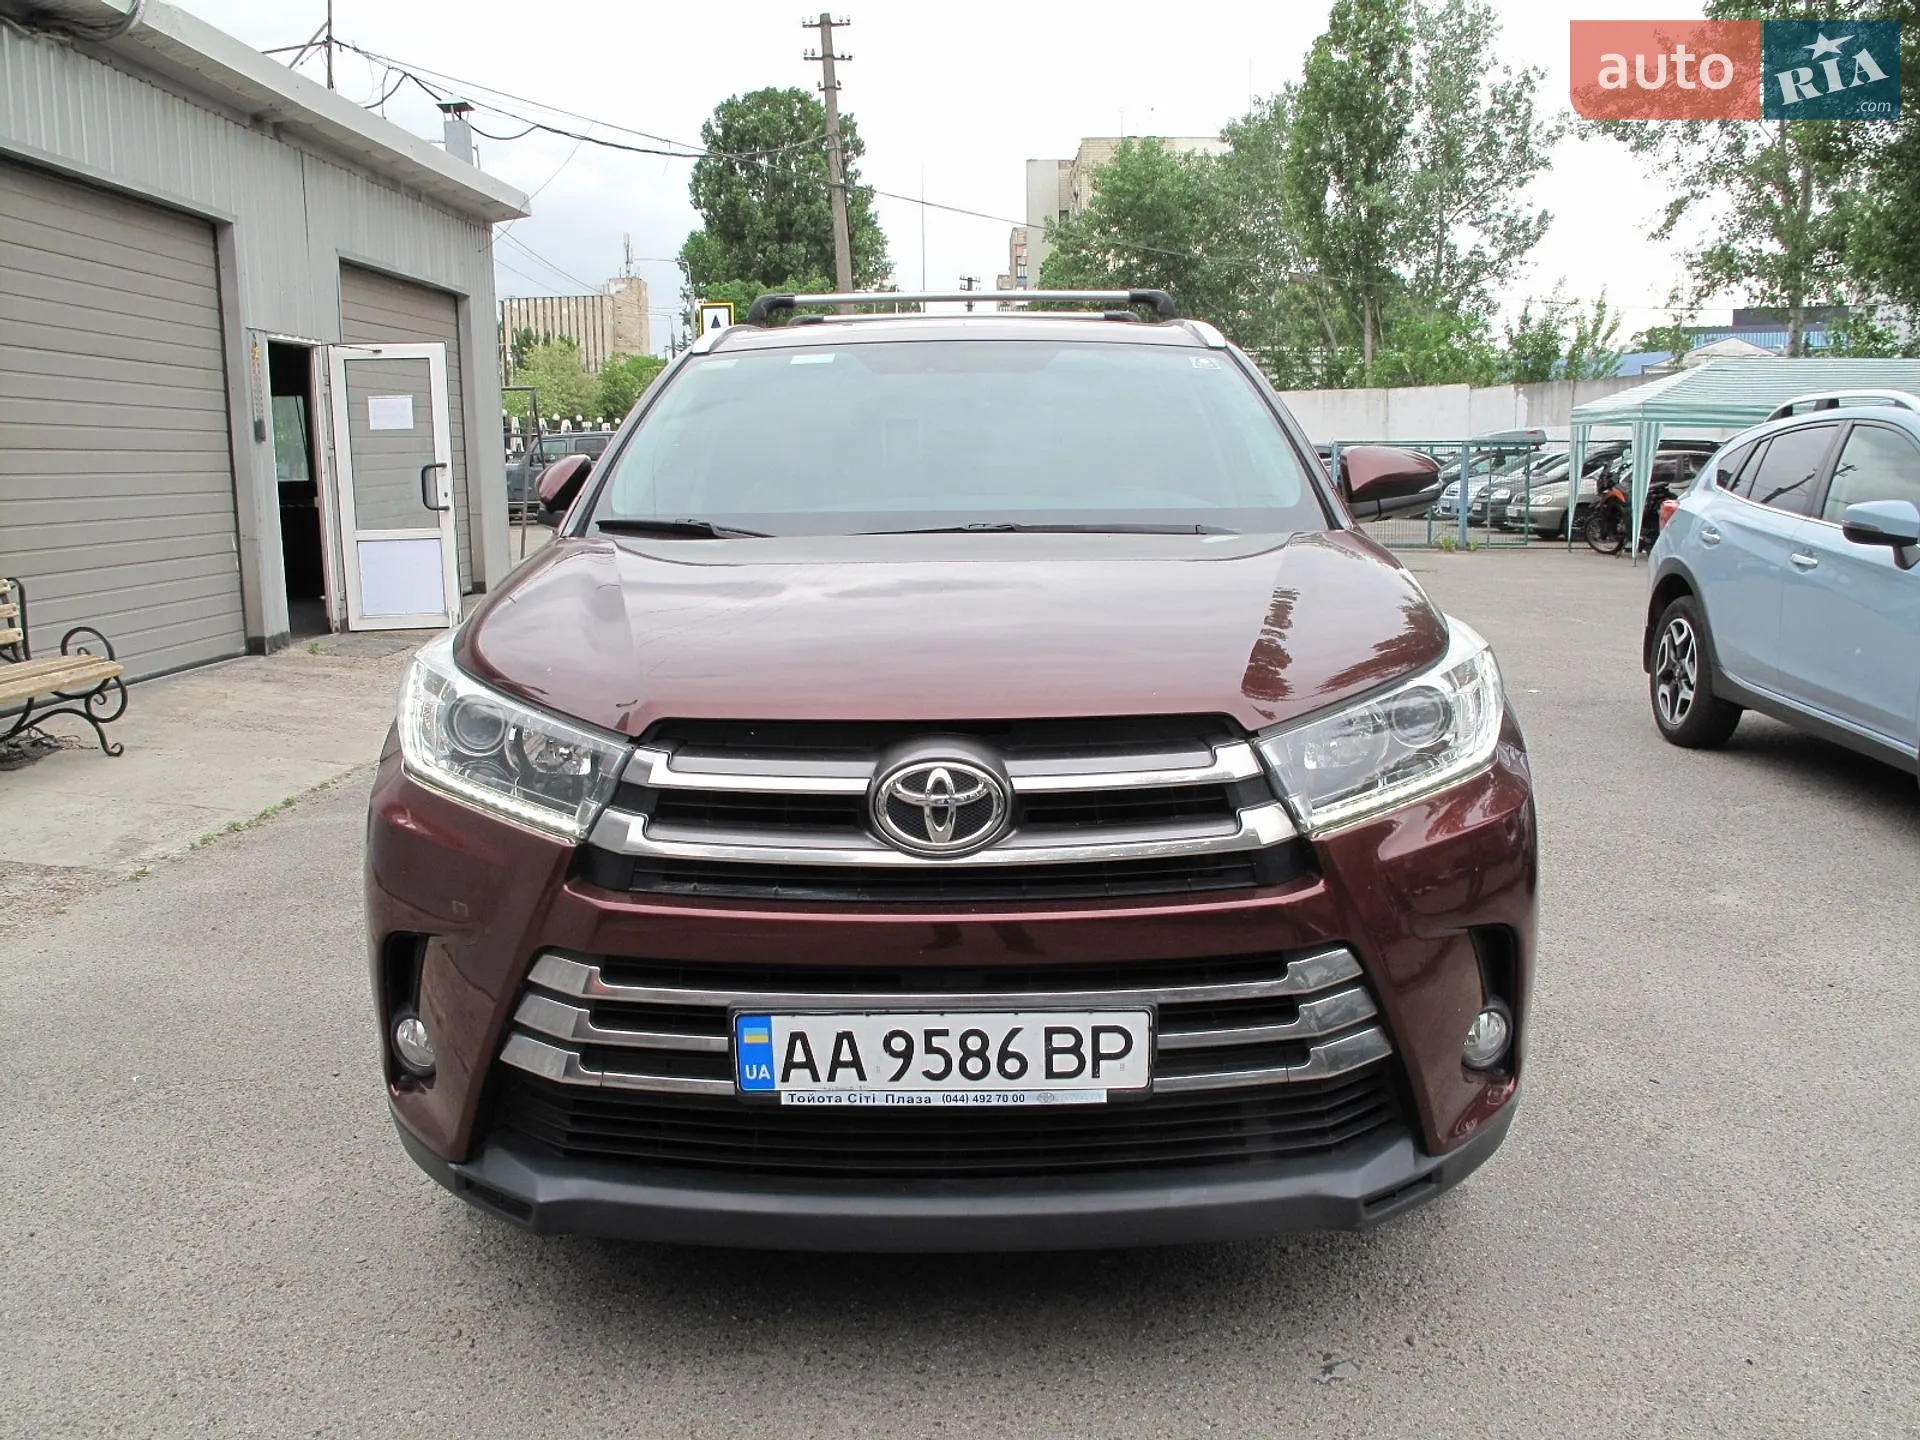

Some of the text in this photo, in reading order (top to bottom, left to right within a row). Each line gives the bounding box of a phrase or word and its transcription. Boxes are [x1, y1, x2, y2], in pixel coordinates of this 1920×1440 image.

[780, 1025, 1134, 1083] AA 9586 BP
[746, 1064, 771, 1080] UA
[787, 1093, 1025, 1104] Тойота Сіті Плаза (044) 492 70 00
